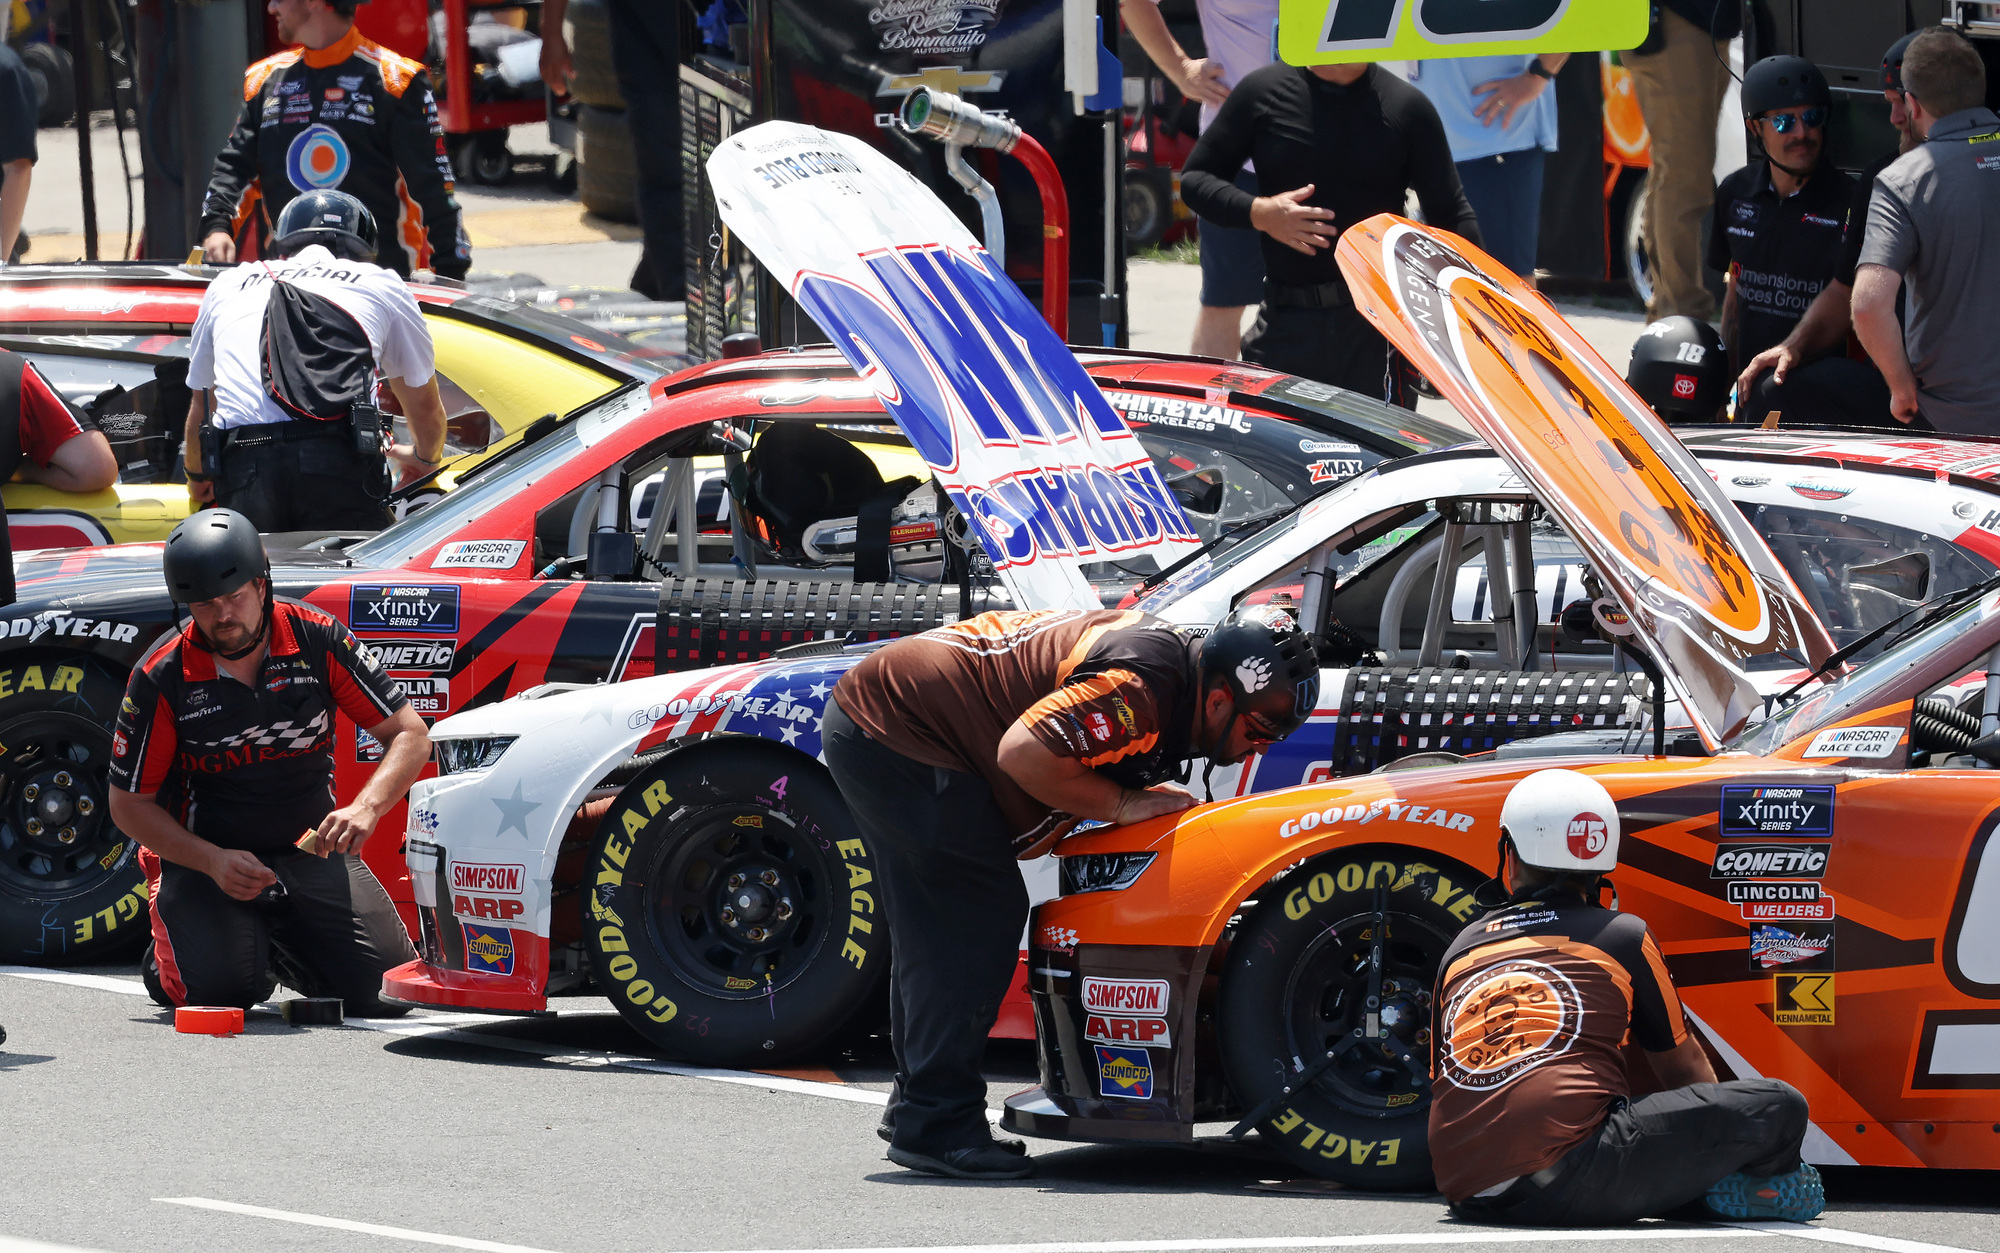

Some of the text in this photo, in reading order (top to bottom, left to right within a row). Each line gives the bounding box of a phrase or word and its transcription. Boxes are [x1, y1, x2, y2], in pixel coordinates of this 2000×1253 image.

[906, 9, 968, 34] Racing
[879, 28, 987, 50] Bommarito
[913, 46, 972, 55] AUTOSPORT
[752, 156, 811, 190] BLUE
[239, 263, 362, 292] OFFICIAL
[1774, 288, 1814, 309] Grou
[792, 243, 1132, 475] KING
[1676, 342, 1706, 364] 18
[1127, 411, 1216, 432] SMOKELESS
[1307, 460, 1364, 485] ZMAX
[445, 554, 506, 565] RACE CAR
[464, 543, 512, 554] NASCAR
[1618, 500, 1747, 613] BEARD
[393, 588, 430, 597] NASCAR
[367, 597, 441, 622] xfinity
[389, 618, 419, 626] SERIES
[371, 644, 453, 665] OMETIC
[628, 691, 814, 730] GOODYEAR
[1112, 696, 1139, 737] SUNOCO
[1837, 730, 1889, 741] NASCAR
[181, 743, 254, 774] DGM
[1818, 744, 1882, 753] RACE CAR
[769, 775, 789, 800] 4
[1764, 788, 1803, 798] NASCAR
[1280, 797, 1475, 839] GOODYEAR
[1738, 800, 1816, 826] xfinity
[1568, 816, 1607, 852] M5
[1760, 821, 1792, 831] SERIES
[1716, 849, 1826, 872] COMETIC
[454, 865, 519, 890] SIMPSON
[1284, 860, 1478, 923] GOODYE
[1733, 886, 1816, 901] LINCOLN
[454, 894, 525, 920] ARP
[836, 838, 876, 970] EAGLE
[1753, 904, 1825, 917] WELDERS
[470, 940, 513, 957] SUNOCO
[1751, 930, 1831, 948] Arrowhead
[1766, 948, 1800, 960] Brass
[1087, 983, 1162, 1010] SIMPSON
[1087, 1016, 1167, 1042] ARP
[1776, 1013, 1832, 1024] KENNAMETAL
[1467, 1034, 1533, 1067] GUYZ
[1103, 1064, 1147, 1081] SUNOCO
[1466, 1074, 1487, 1086] VAN
[1489, 1070, 1508, 1084] DER
[1270, 1107, 1402, 1167] EAGLE
